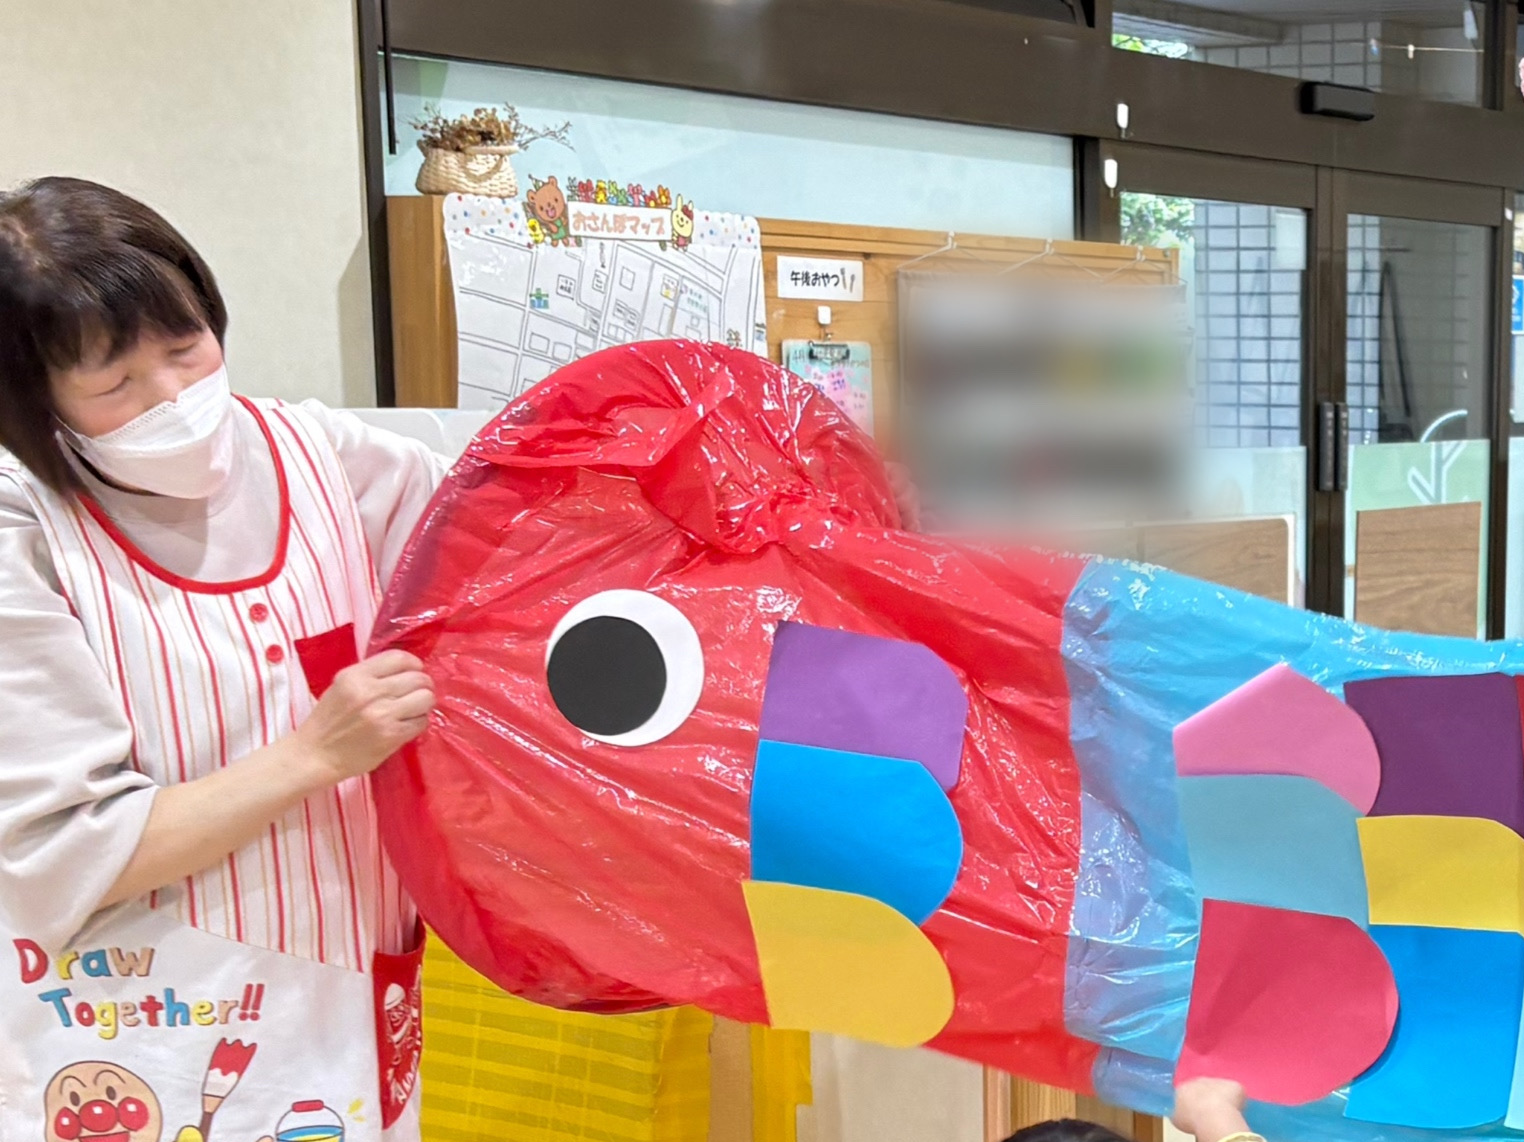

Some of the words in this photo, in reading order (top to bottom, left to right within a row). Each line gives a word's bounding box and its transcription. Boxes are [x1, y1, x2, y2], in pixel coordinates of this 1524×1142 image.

[790, 270, 840, 288] 午後おやつ
[12, 938, 155, 984] Draw
[37, 983, 265, 1039] Together!!
